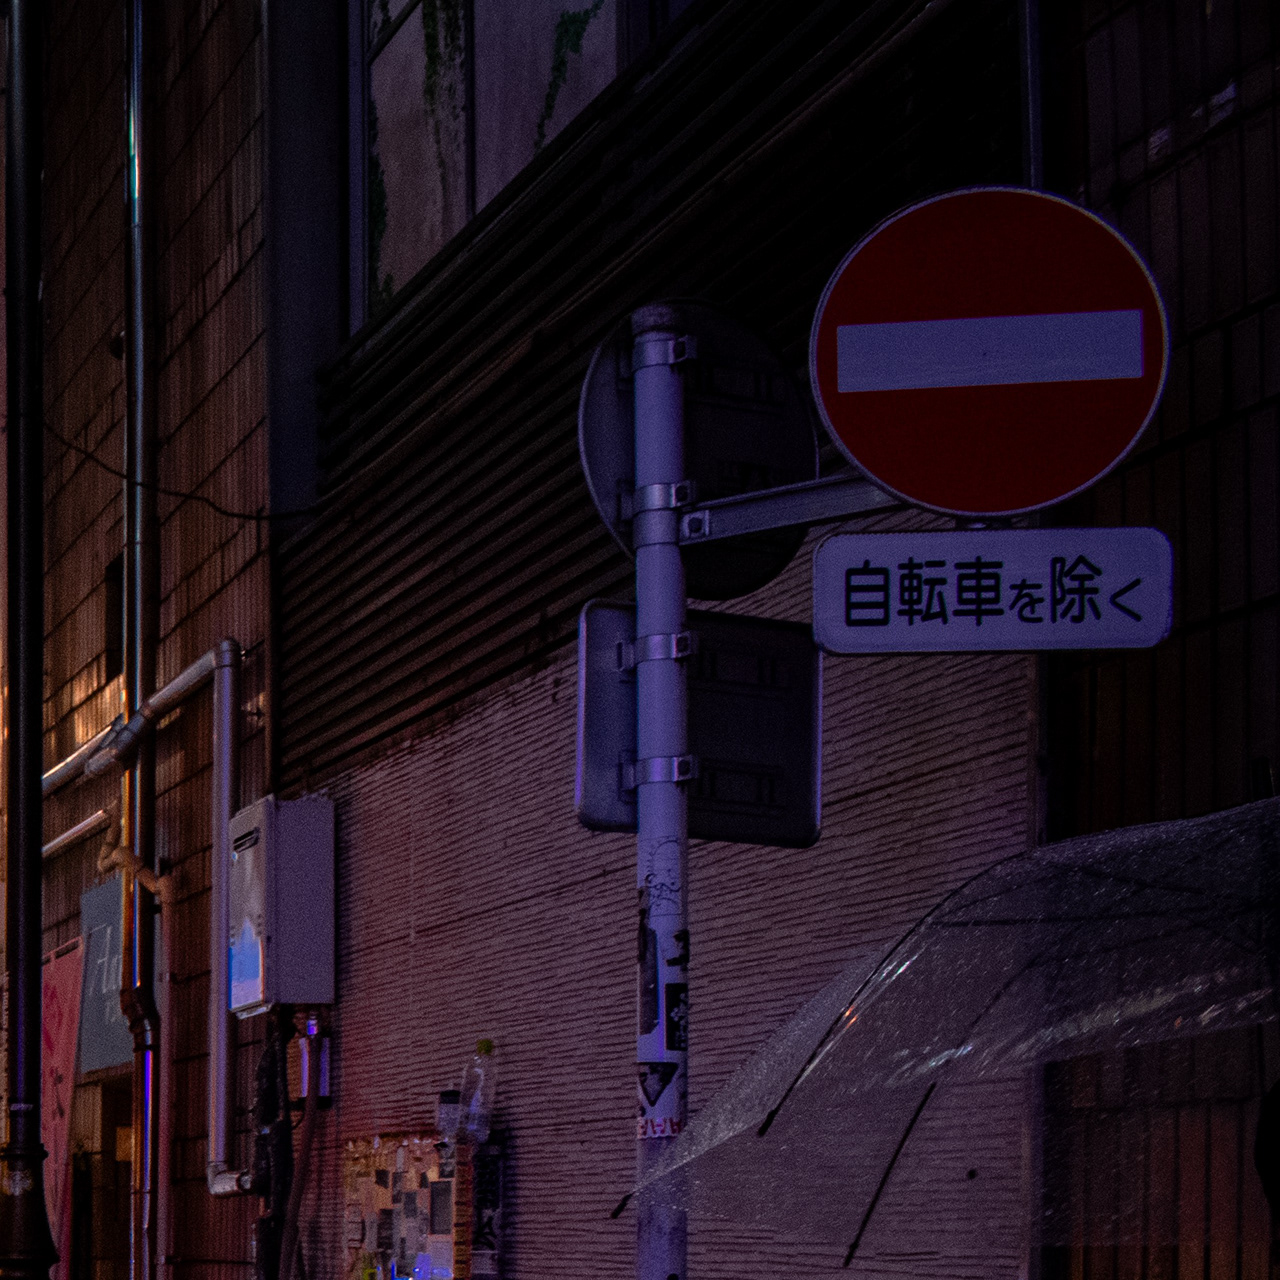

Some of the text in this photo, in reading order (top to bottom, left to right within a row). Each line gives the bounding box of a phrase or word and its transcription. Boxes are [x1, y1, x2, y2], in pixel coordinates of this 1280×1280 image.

[844, 554, 1143, 627] 自転車を除く
